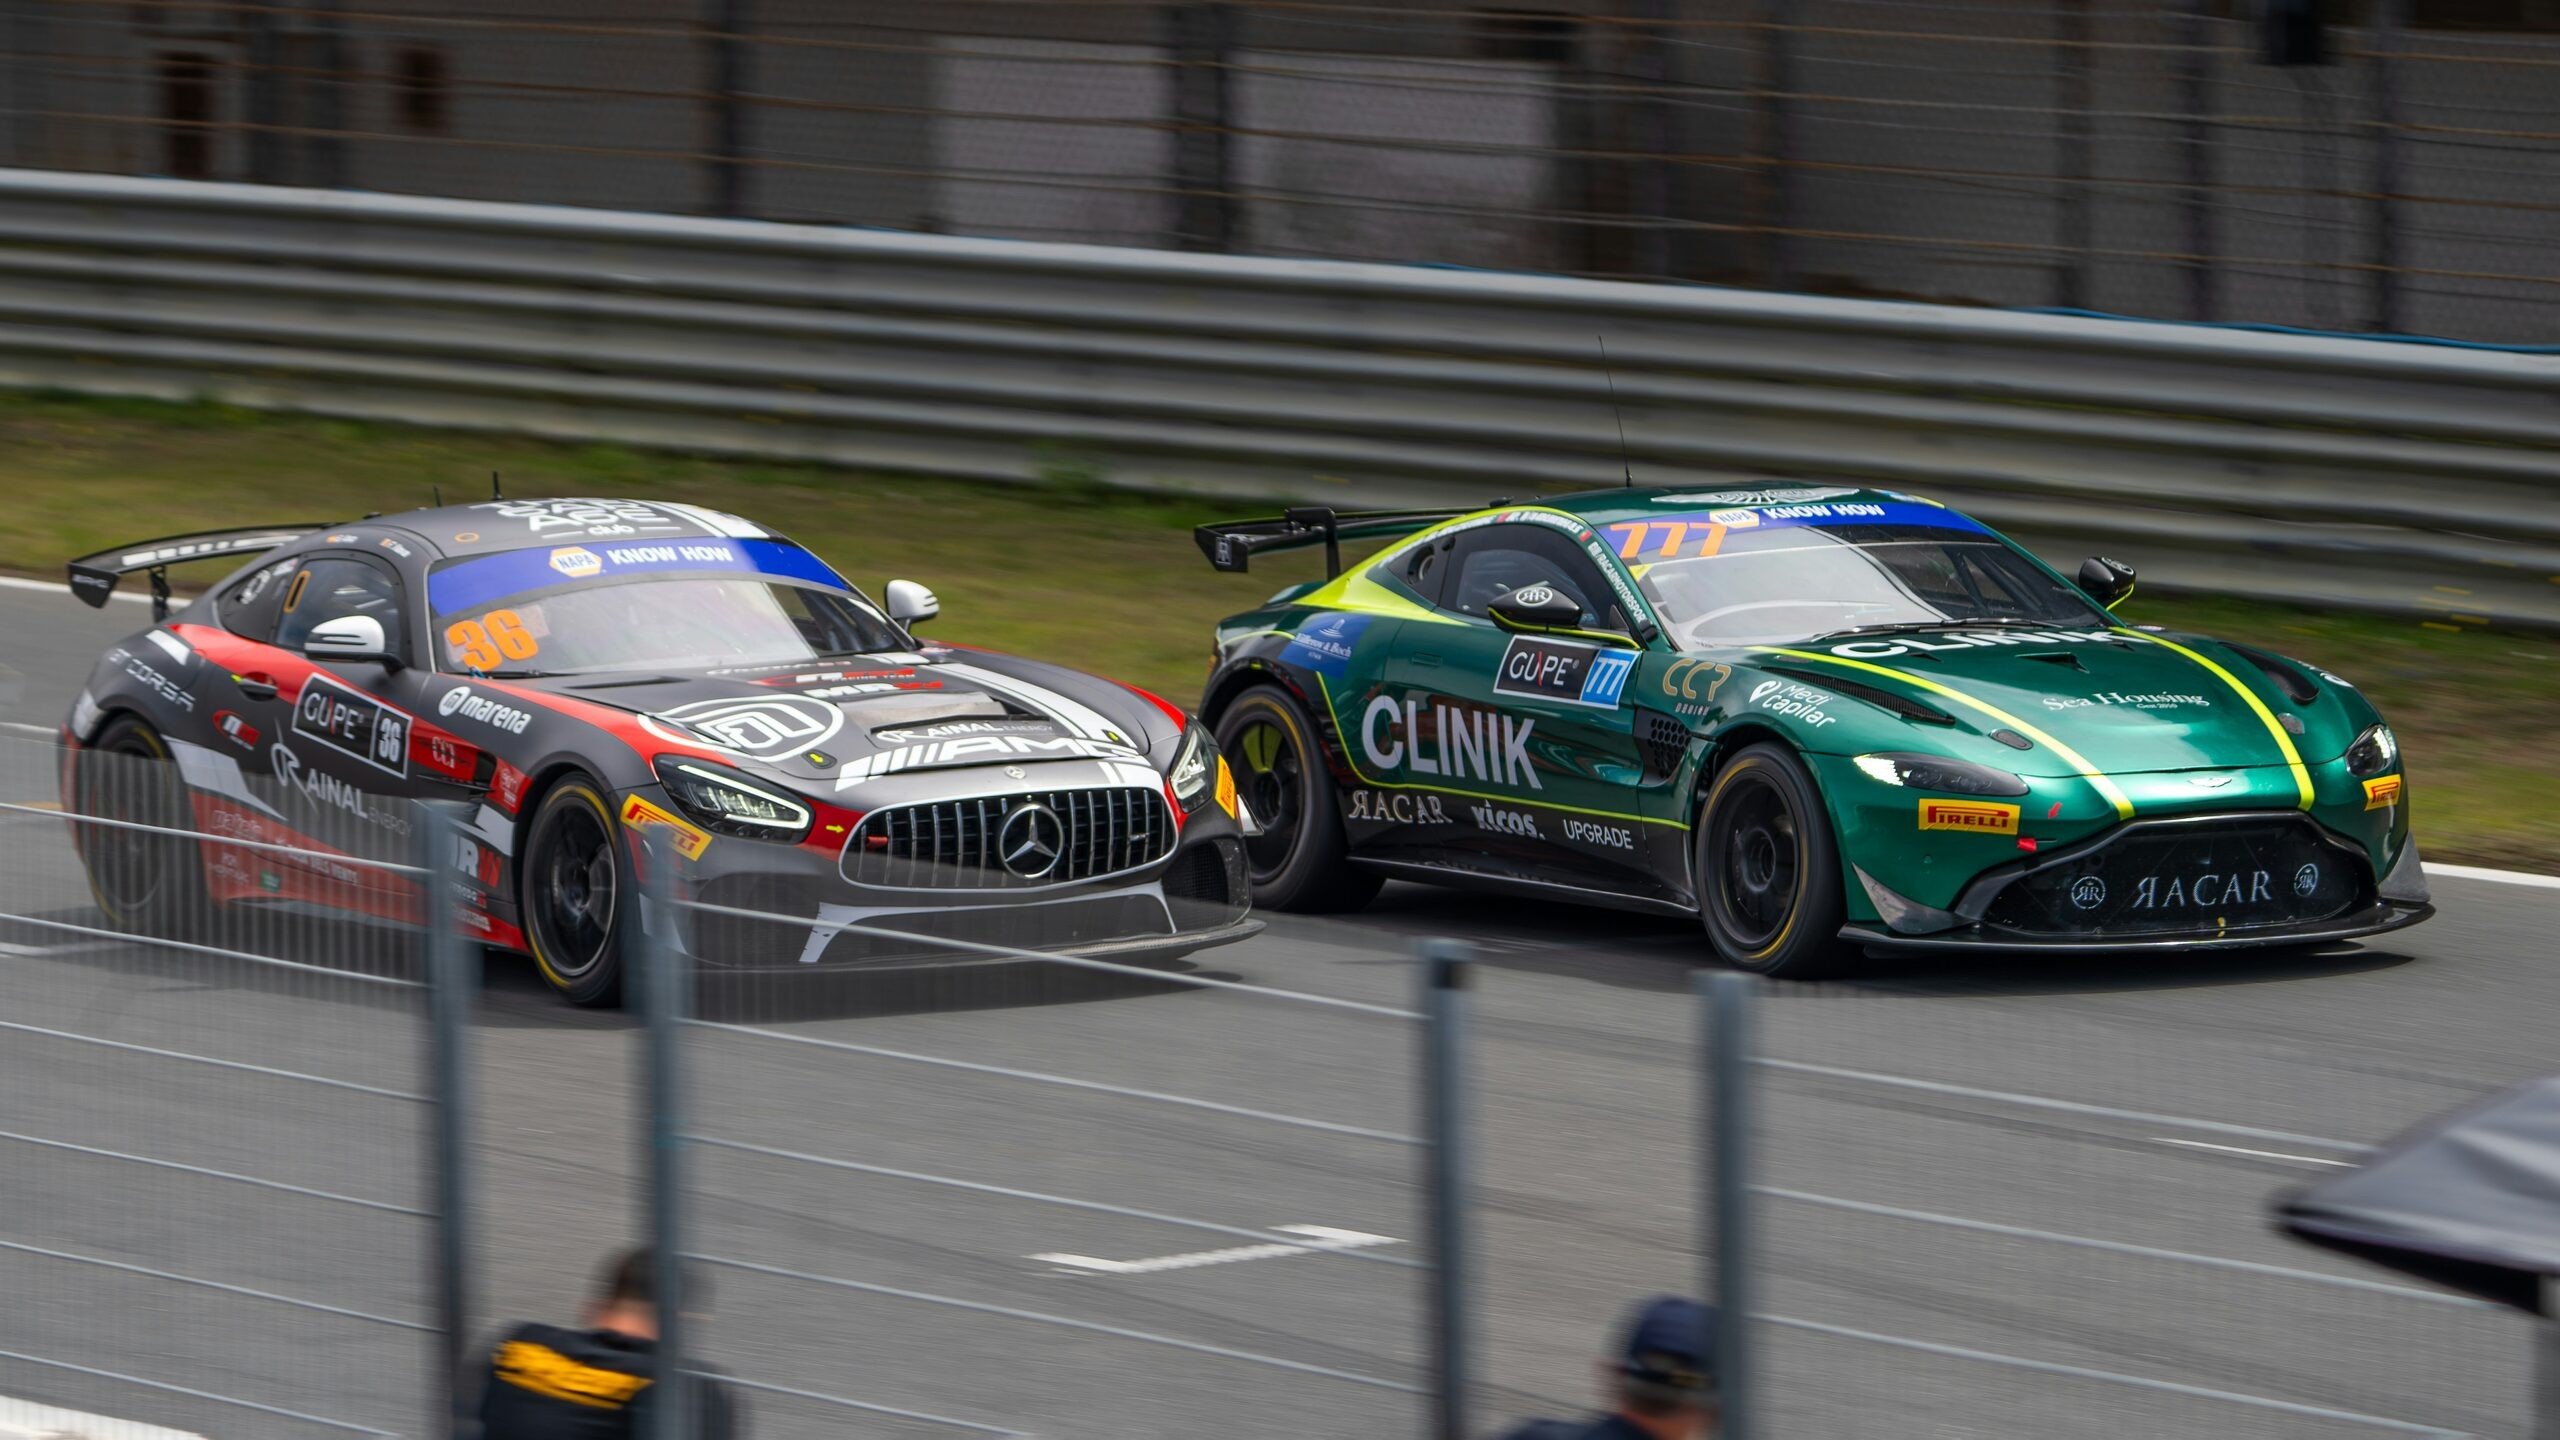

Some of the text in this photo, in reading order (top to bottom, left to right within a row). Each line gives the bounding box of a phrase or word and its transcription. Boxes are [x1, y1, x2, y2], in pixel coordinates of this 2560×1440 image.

[1717, 509, 1751, 524] NAPA
[1763, 503, 1886, 520] KNOW HOW
[588, 524, 636, 537] club
[1609, 522, 1728, 558] 777
[556, 554, 596, 569] NAPA
[606, 546, 734, 566] KNOW HOW
[447, 609, 539, 672] 36
[1831, 631, 2152, 658] CLINIK
[1586, 657, 1630, 697] 777
[1781, 683, 1831, 705] Medi
[2042, 690, 2211, 711] Sea Housing
[458, 695, 532, 734] marena
[377, 717, 401, 762] 36
[1362, 694, 1543, 790] CLINIK
[1927, 805, 2010, 829] PIRELLI
[1563, 818, 1634, 850] UPGRADE
